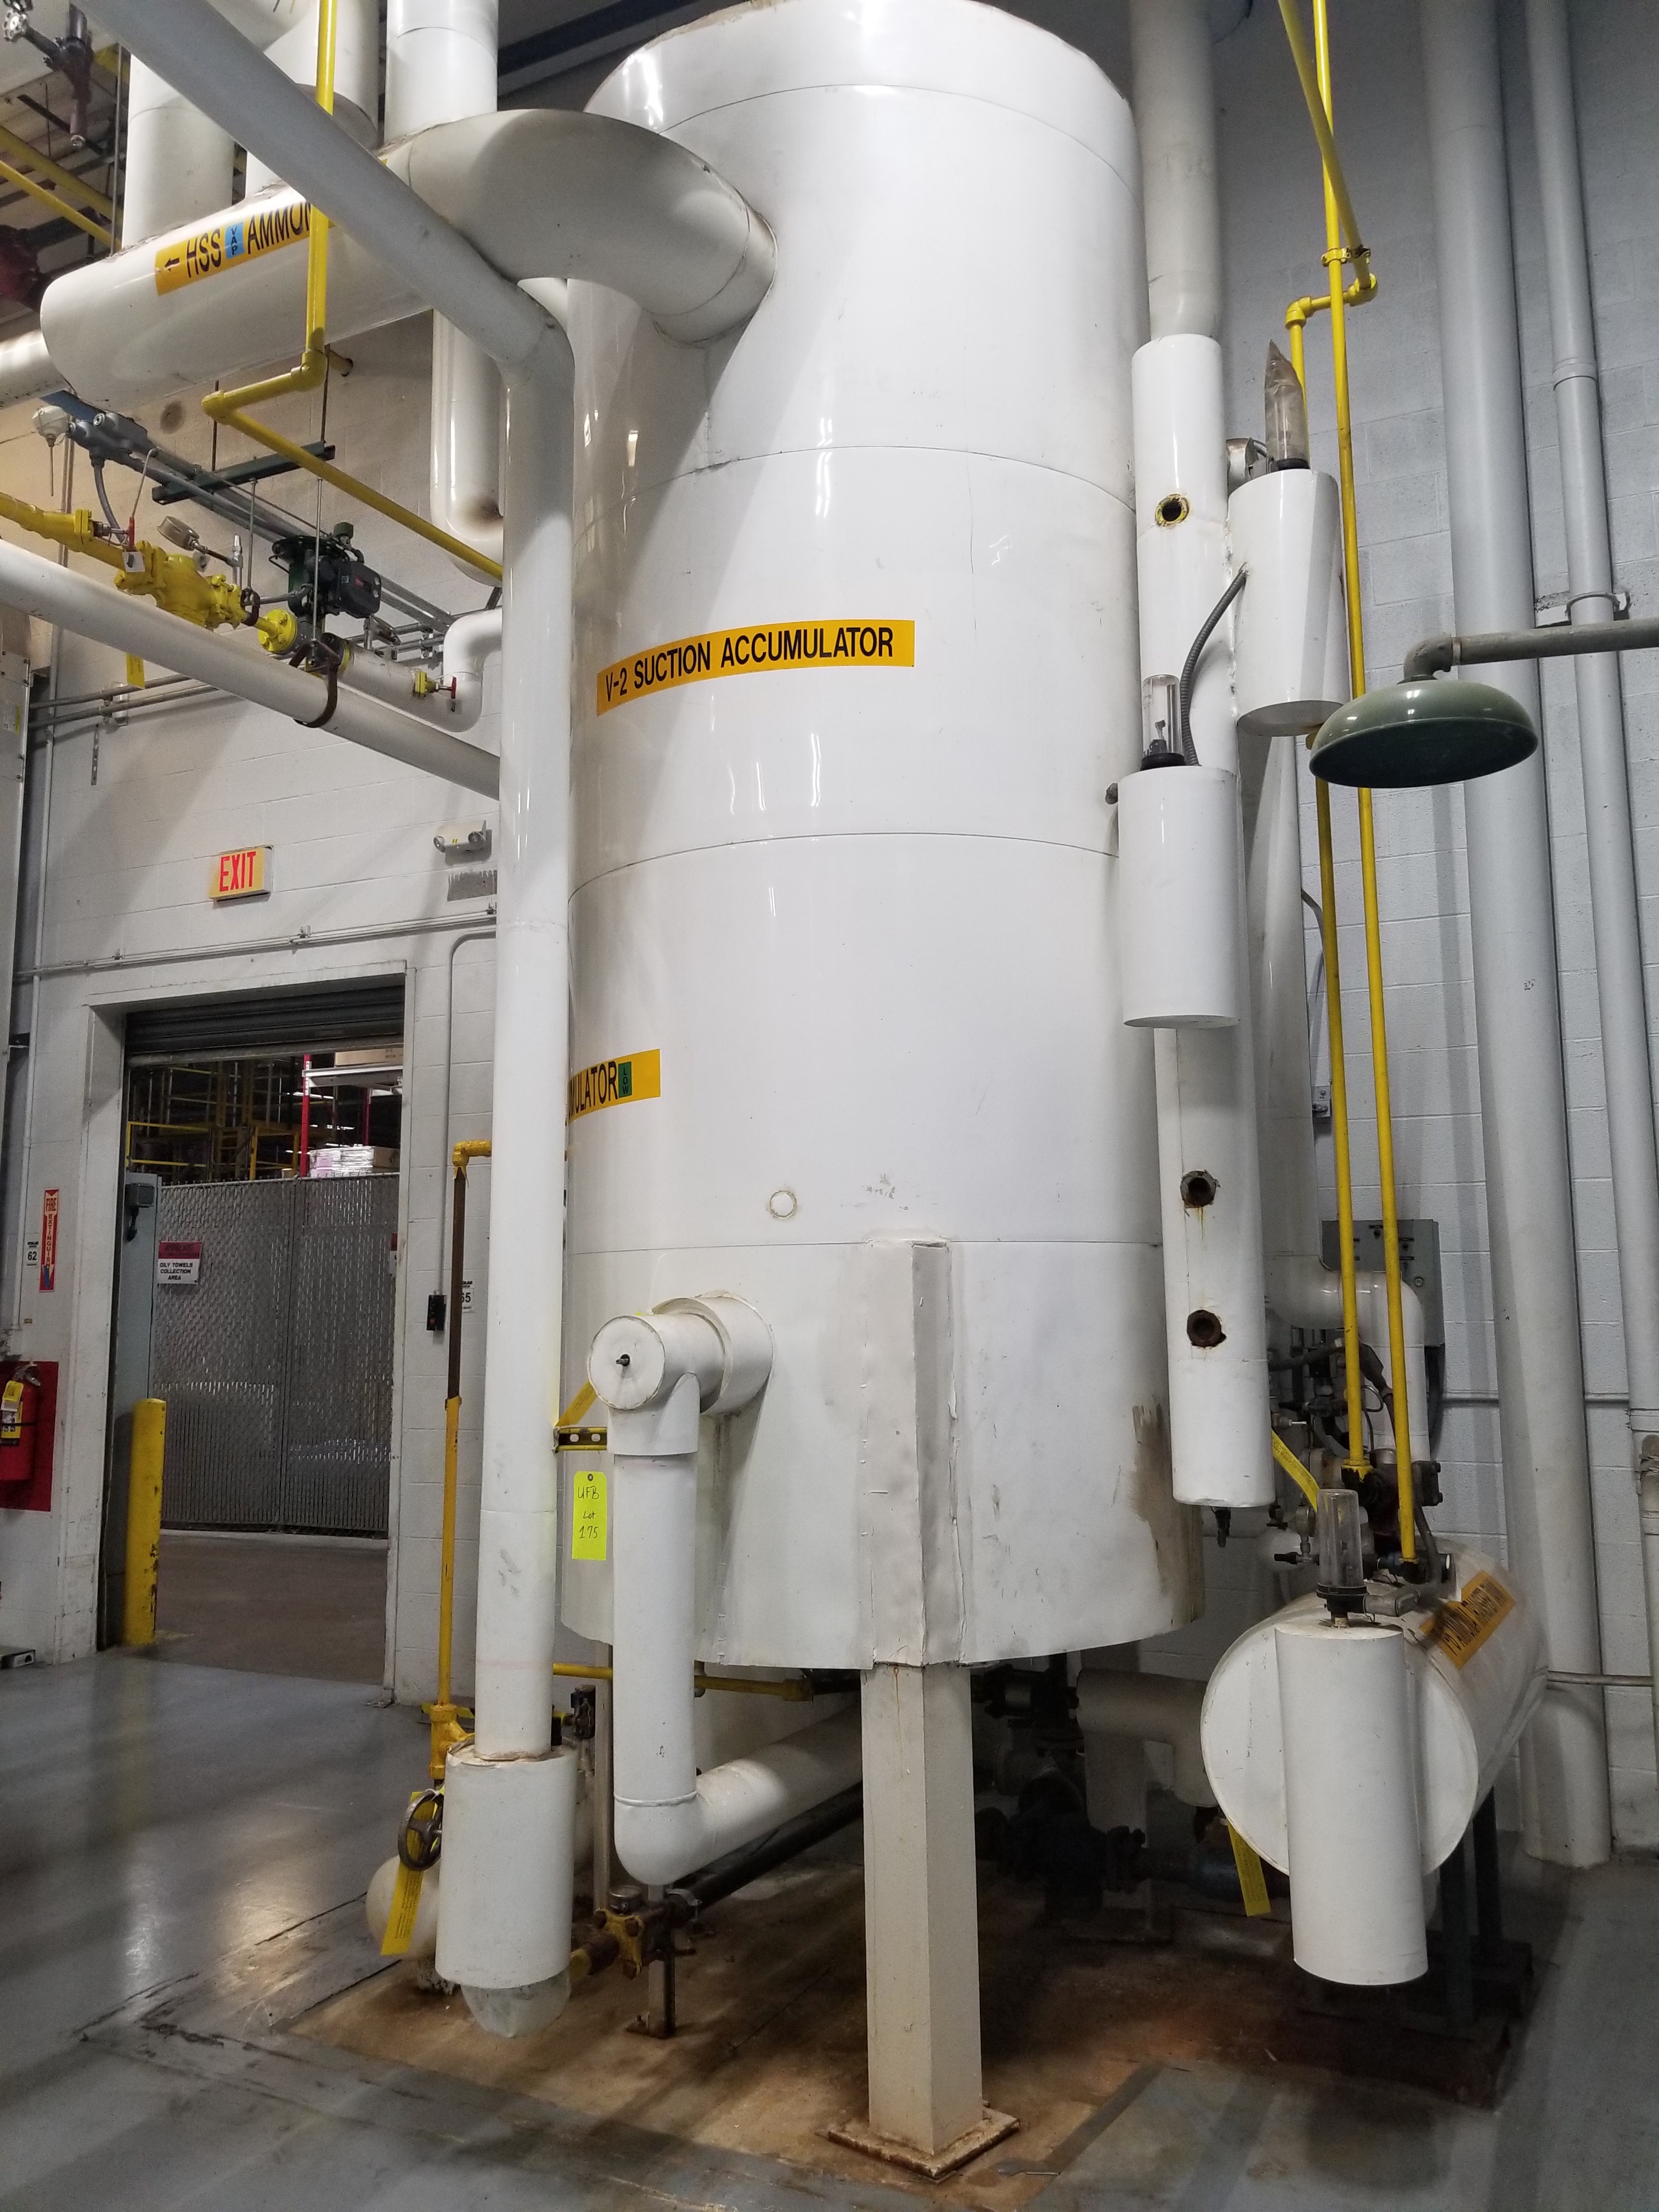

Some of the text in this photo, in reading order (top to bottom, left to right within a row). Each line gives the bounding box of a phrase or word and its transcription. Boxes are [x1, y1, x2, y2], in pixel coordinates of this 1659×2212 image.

[187, 229, 222, 278] HSS
[606, 627, 893, 702] V-2 SUCTION ACCUMULATOR
[219, 851, 256, 892] EXIT
[46, 1197, 57, 1212] FIRE
[28, 1251, 37, 1261] 62
[578, 1486, 600, 1500] UFB
[579, 1525, 599, 1539] 175
